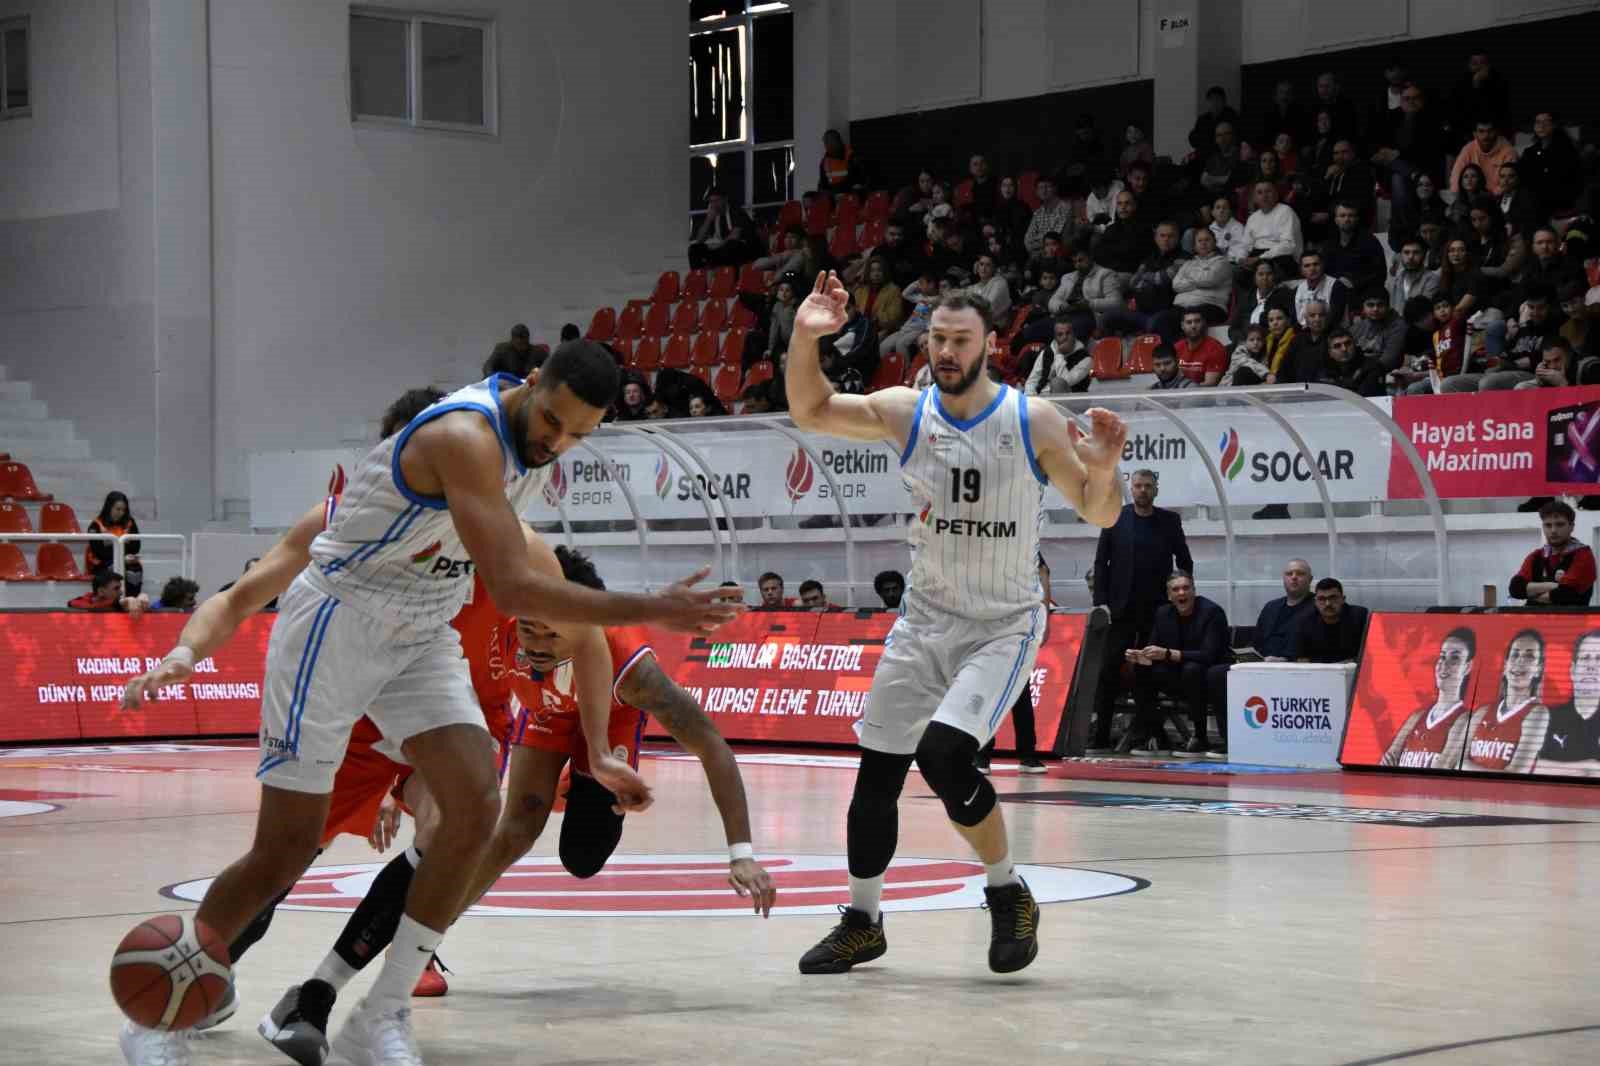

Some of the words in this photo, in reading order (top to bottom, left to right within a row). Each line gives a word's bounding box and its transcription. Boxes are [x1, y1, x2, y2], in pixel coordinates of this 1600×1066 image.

[1412, 420, 1475, 448] Hayat
[1482, 419, 1534, 441] Sana
[1121, 434, 1186, 461] etkim
[1427, 449, 1533, 472] Maximum
[822, 449, 888, 474] Petkim
[1251, 449, 1354, 482] SOCAR
[571, 491, 612, 505] SPOR
[951, 468, 981, 503] 19
[431, 555, 474, 578] PET
[77, 657, 141, 674] KADINLAR
[705, 643, 778, 669] KADINLAR
[779, 645, 864, 671] BASKETBOL
[38, 683, 86, 703] DÜNYA
[90, 685, 127, 702] KUPA
[190, 682, 260, 699] TURNUVASI
[704, 687, 759, 713] KUPASI
[760, 688, 812, 715] ELEME
[814, 689, 866, 717] TURNU
